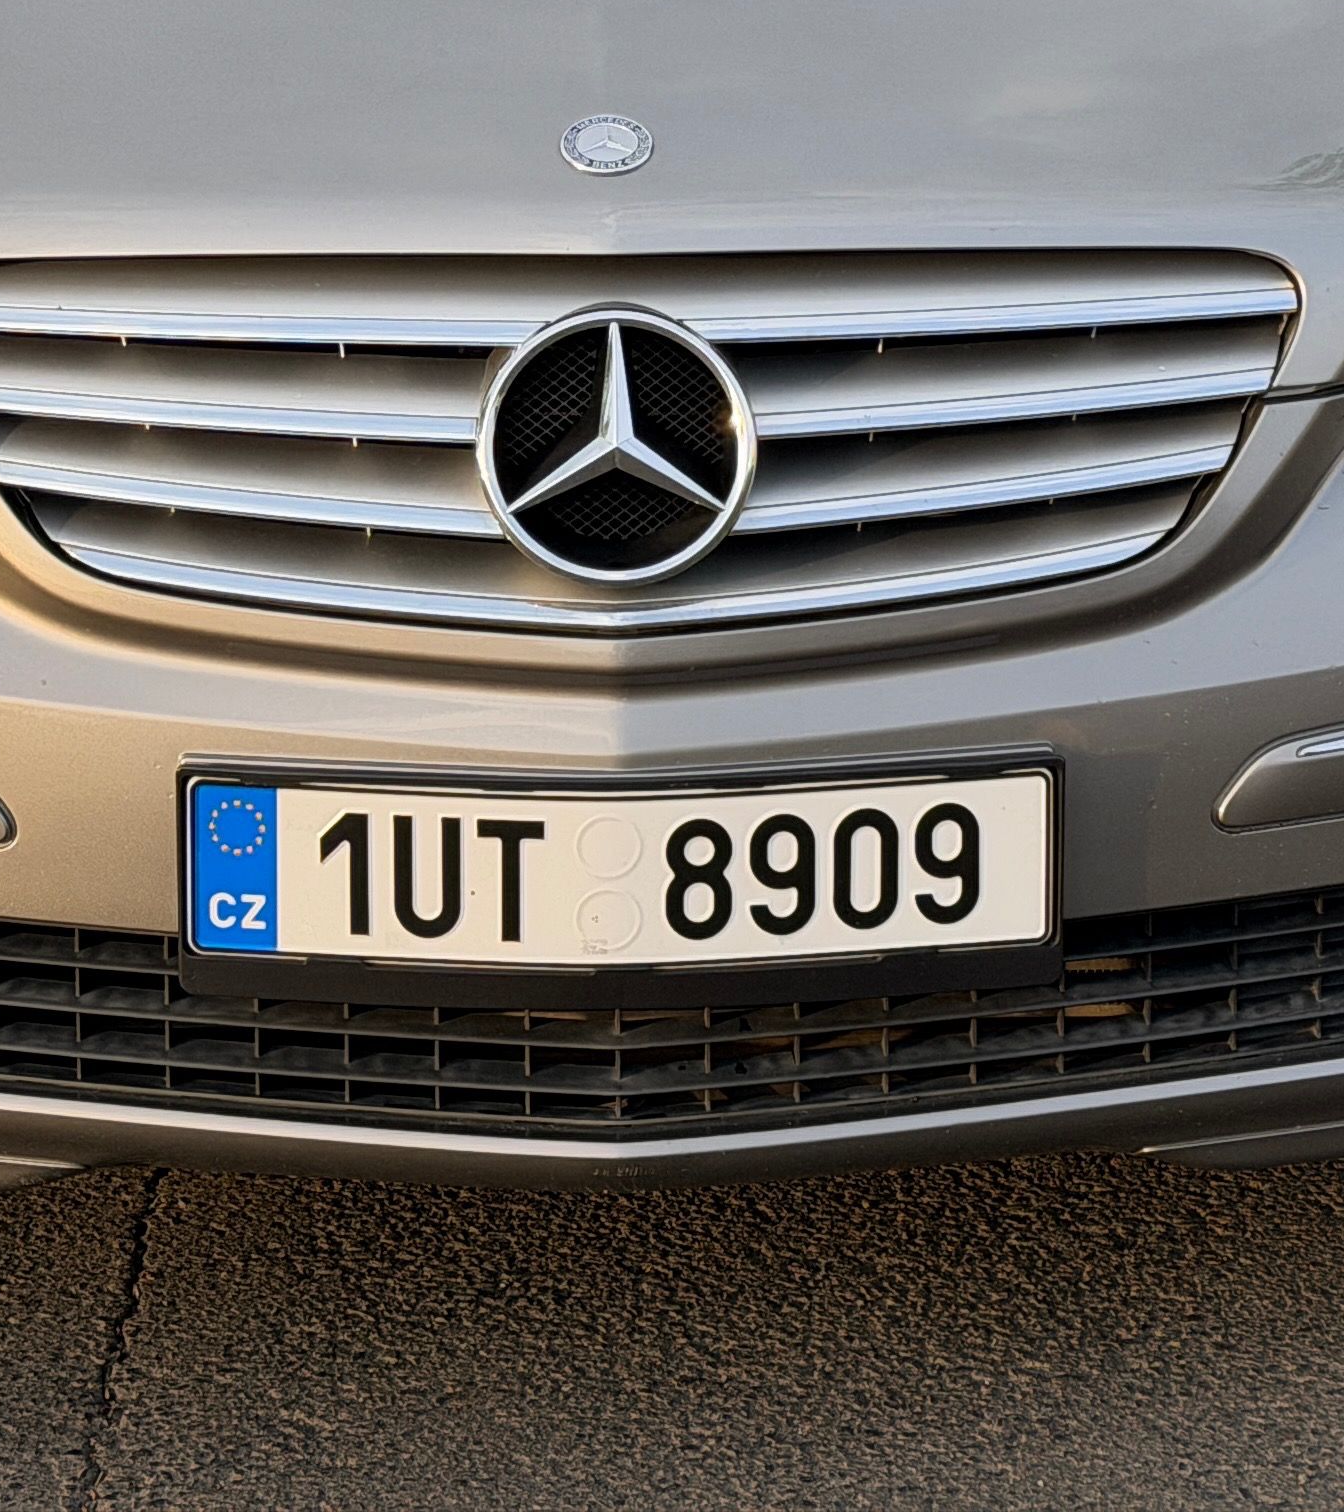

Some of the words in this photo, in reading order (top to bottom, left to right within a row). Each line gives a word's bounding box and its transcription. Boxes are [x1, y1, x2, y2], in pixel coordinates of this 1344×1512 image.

[591, 160, 625, 169] BENZ
[319, 812, 545, 942] 1UT
[665, 802, 980, 940] 8909
[209, 892, 267, 930] CZ
